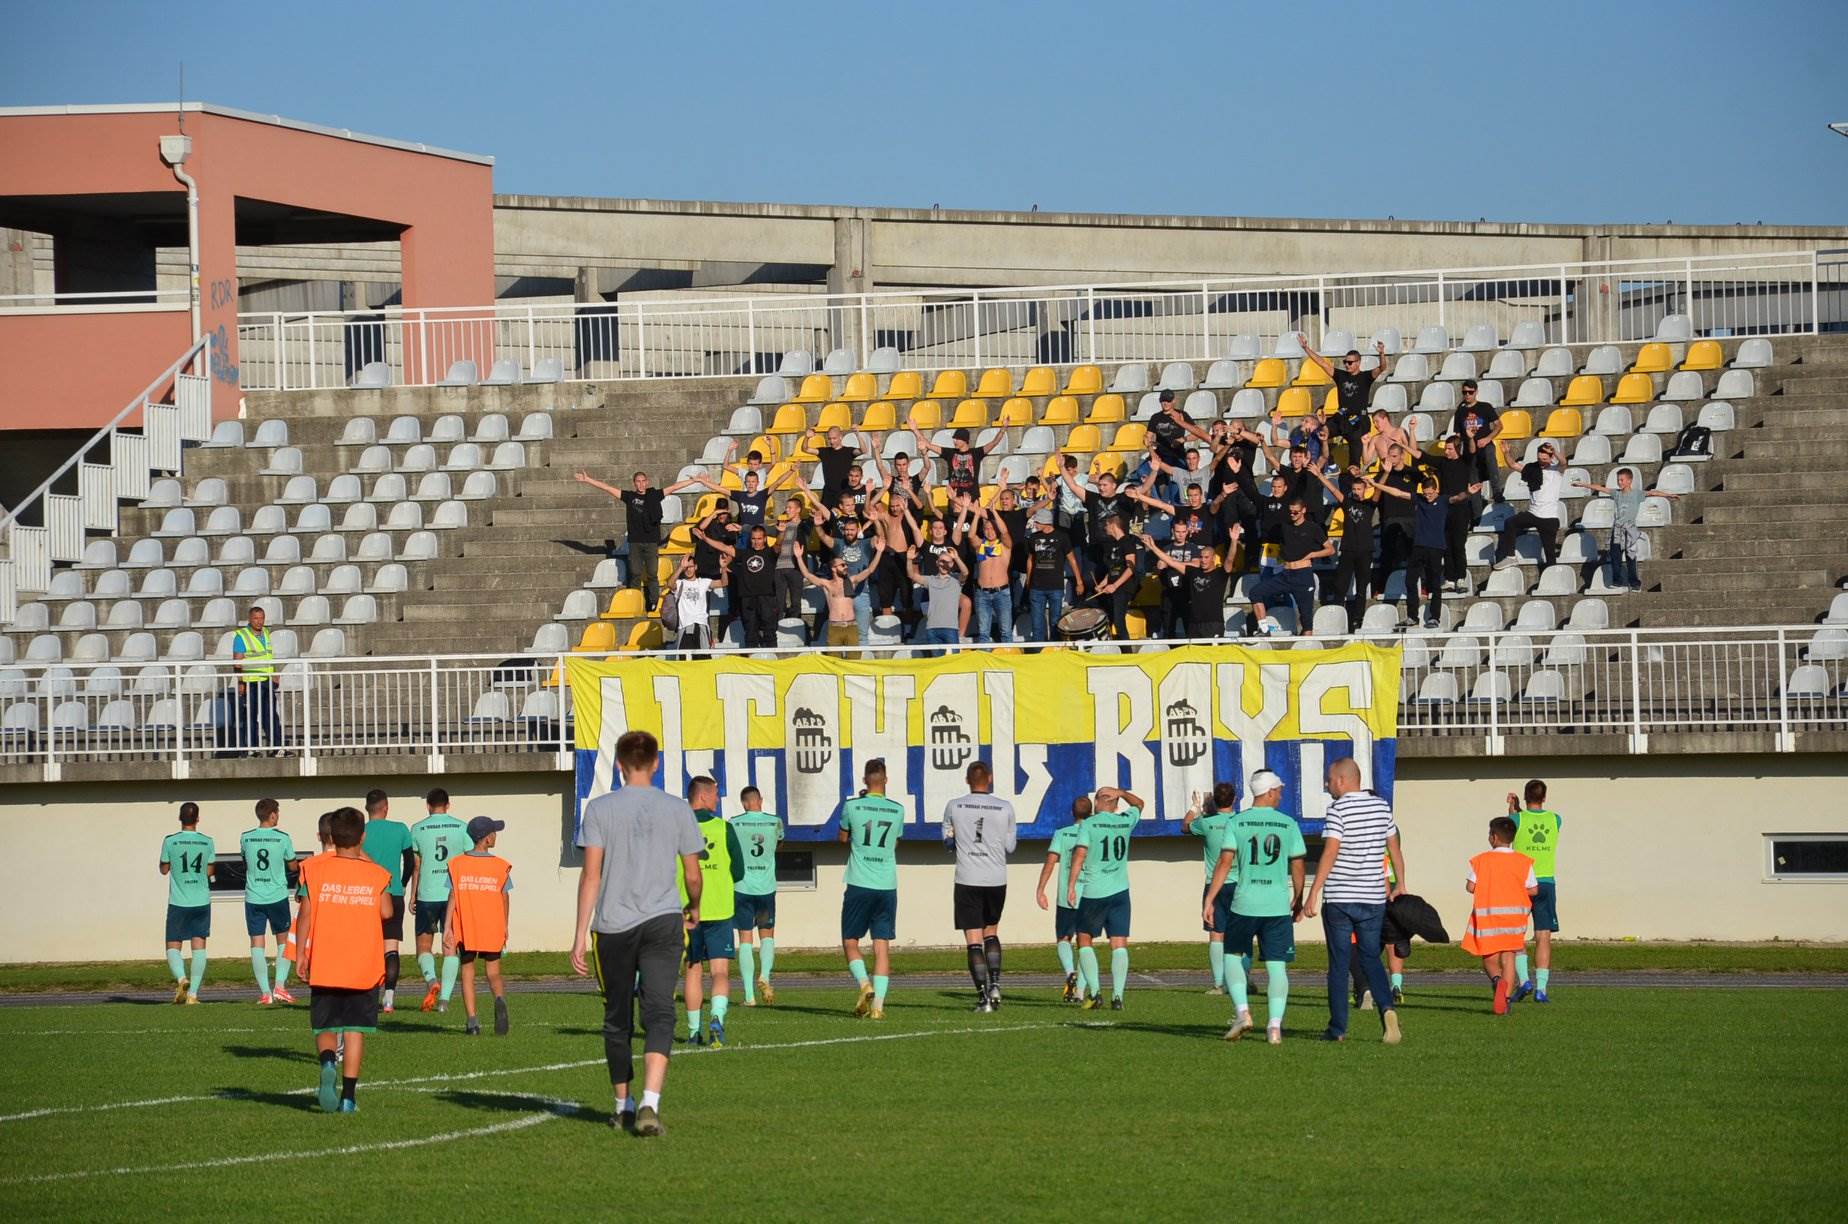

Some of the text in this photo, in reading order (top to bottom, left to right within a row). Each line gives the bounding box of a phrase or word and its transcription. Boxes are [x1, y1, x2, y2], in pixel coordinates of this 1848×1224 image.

[1086, 660, 1374, 822] BOYS
[862, 819, 893, 848] 17
[974, 816, 985, 844] 1
[434, 834, 449, 863] 5
[751, 833, 764, 857] 3
[1099, 834, 1126, 863] 10
[1248, 833, 1281, 866] 19
[180, 850, 203, 873] 14
[257, 848, 270, 871] 8
[321, 882, 373, 896] DAS LEBEN
[461, 875, 498, 885] DAS LEBEN
[468, 883, 480, 891] EIN
[332, 894, 348, 905] EIN
